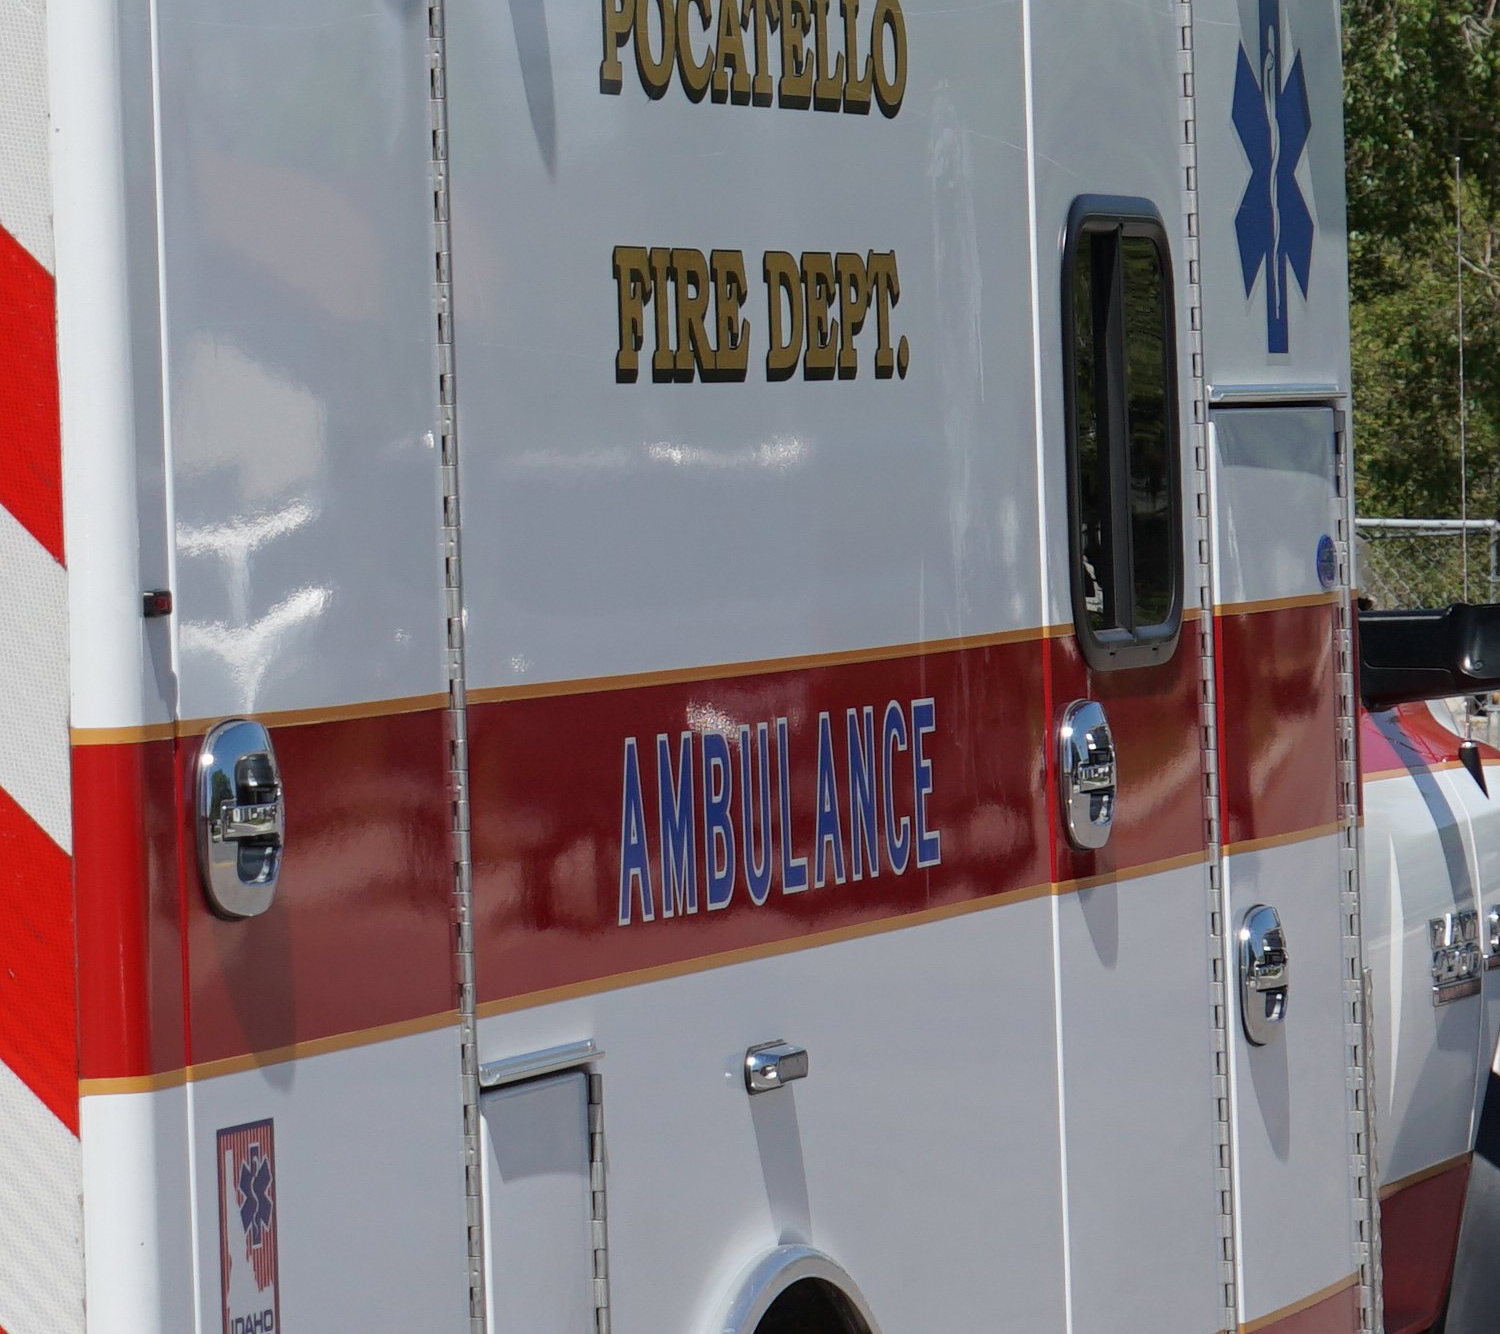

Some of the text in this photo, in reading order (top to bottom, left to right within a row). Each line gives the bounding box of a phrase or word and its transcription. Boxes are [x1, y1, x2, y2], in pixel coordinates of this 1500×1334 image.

[612, 245, 910, 384] FIRE DEPT.
[617, 697, 943, 927] AMBULANCE
